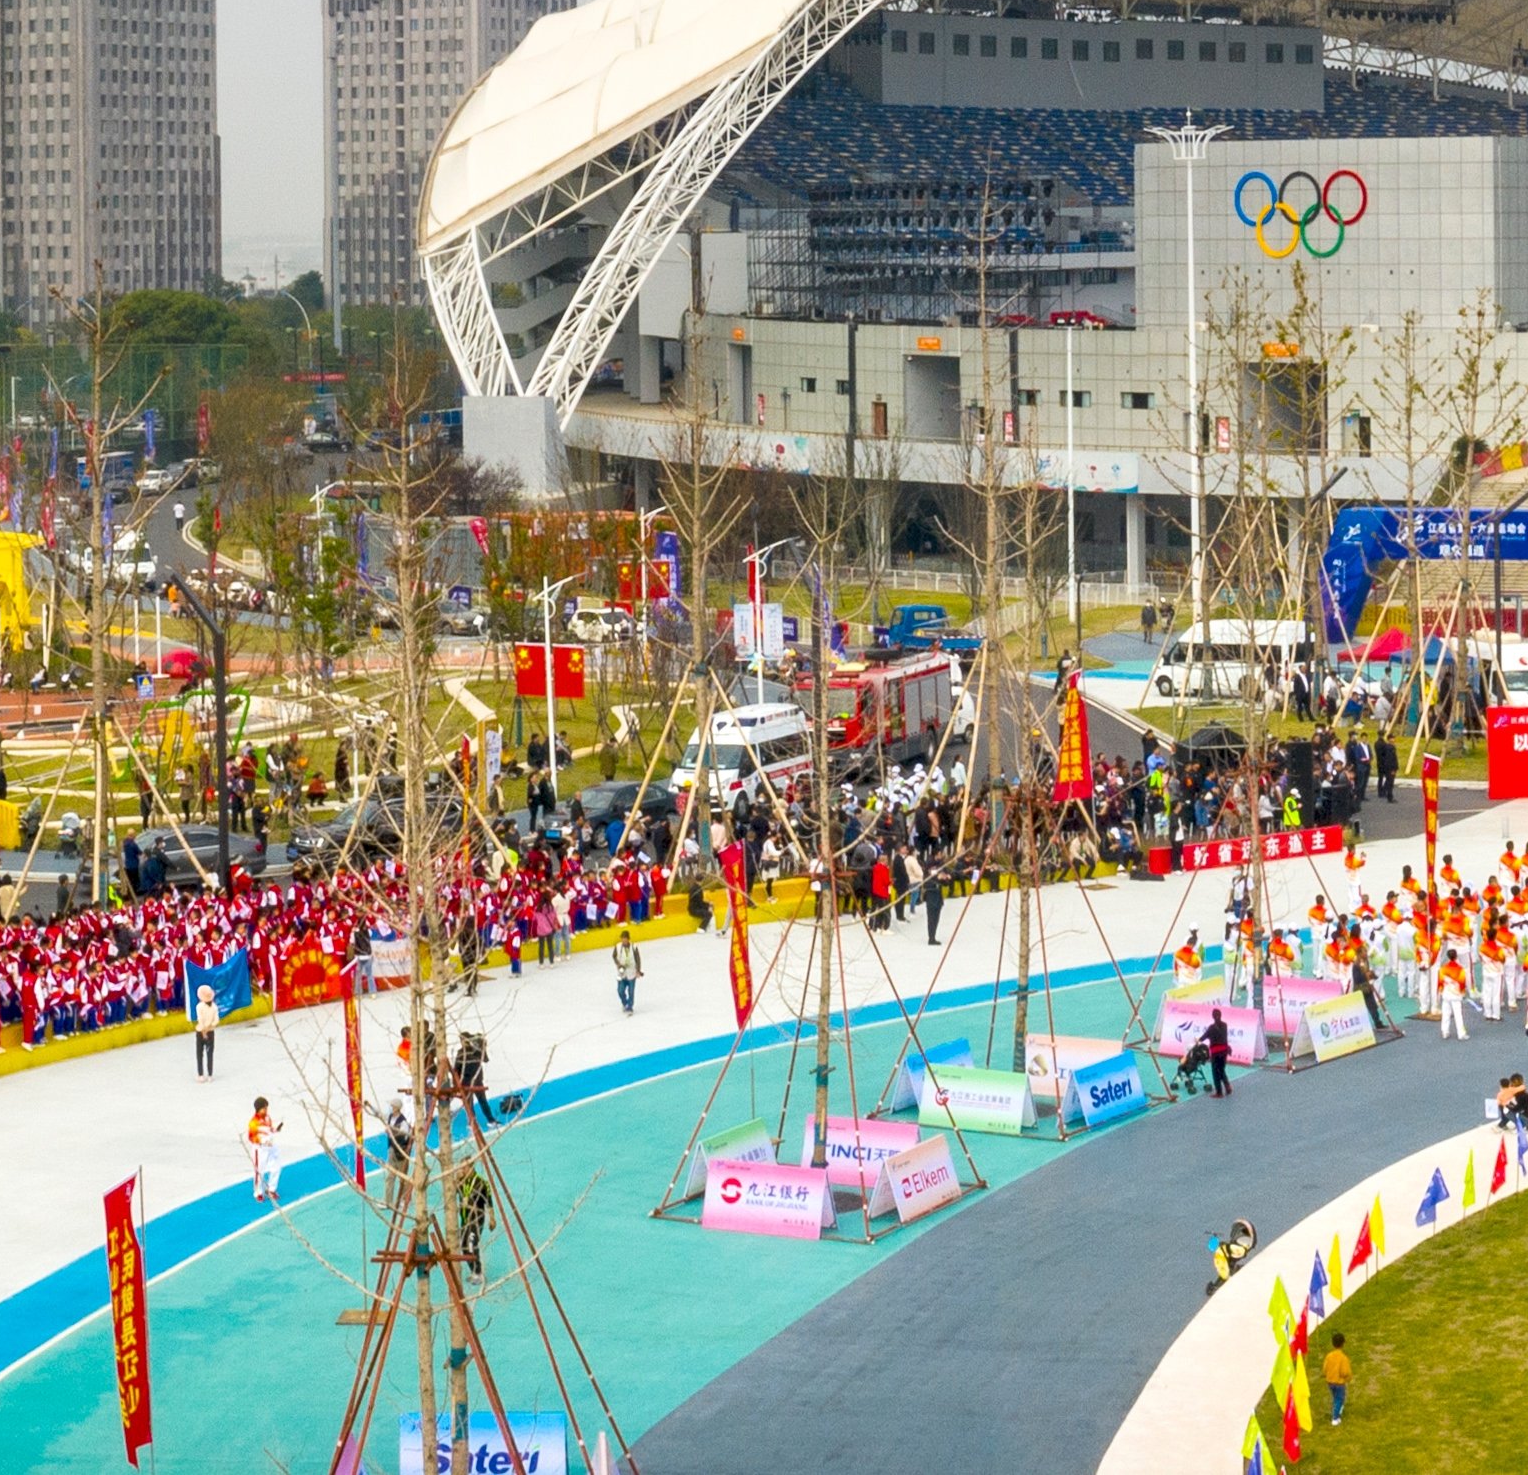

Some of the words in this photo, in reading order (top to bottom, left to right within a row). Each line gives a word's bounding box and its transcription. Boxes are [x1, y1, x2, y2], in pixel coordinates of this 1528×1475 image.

[1090, 1078, 1133, 1109] Sateri
[825, 1144, 872, 1161] INCI
[747, 1182, 809, 1202] 九江银行
[911, 1165, 950, 1193] Elkem
[437, 1443, 540, 1474] Steri
